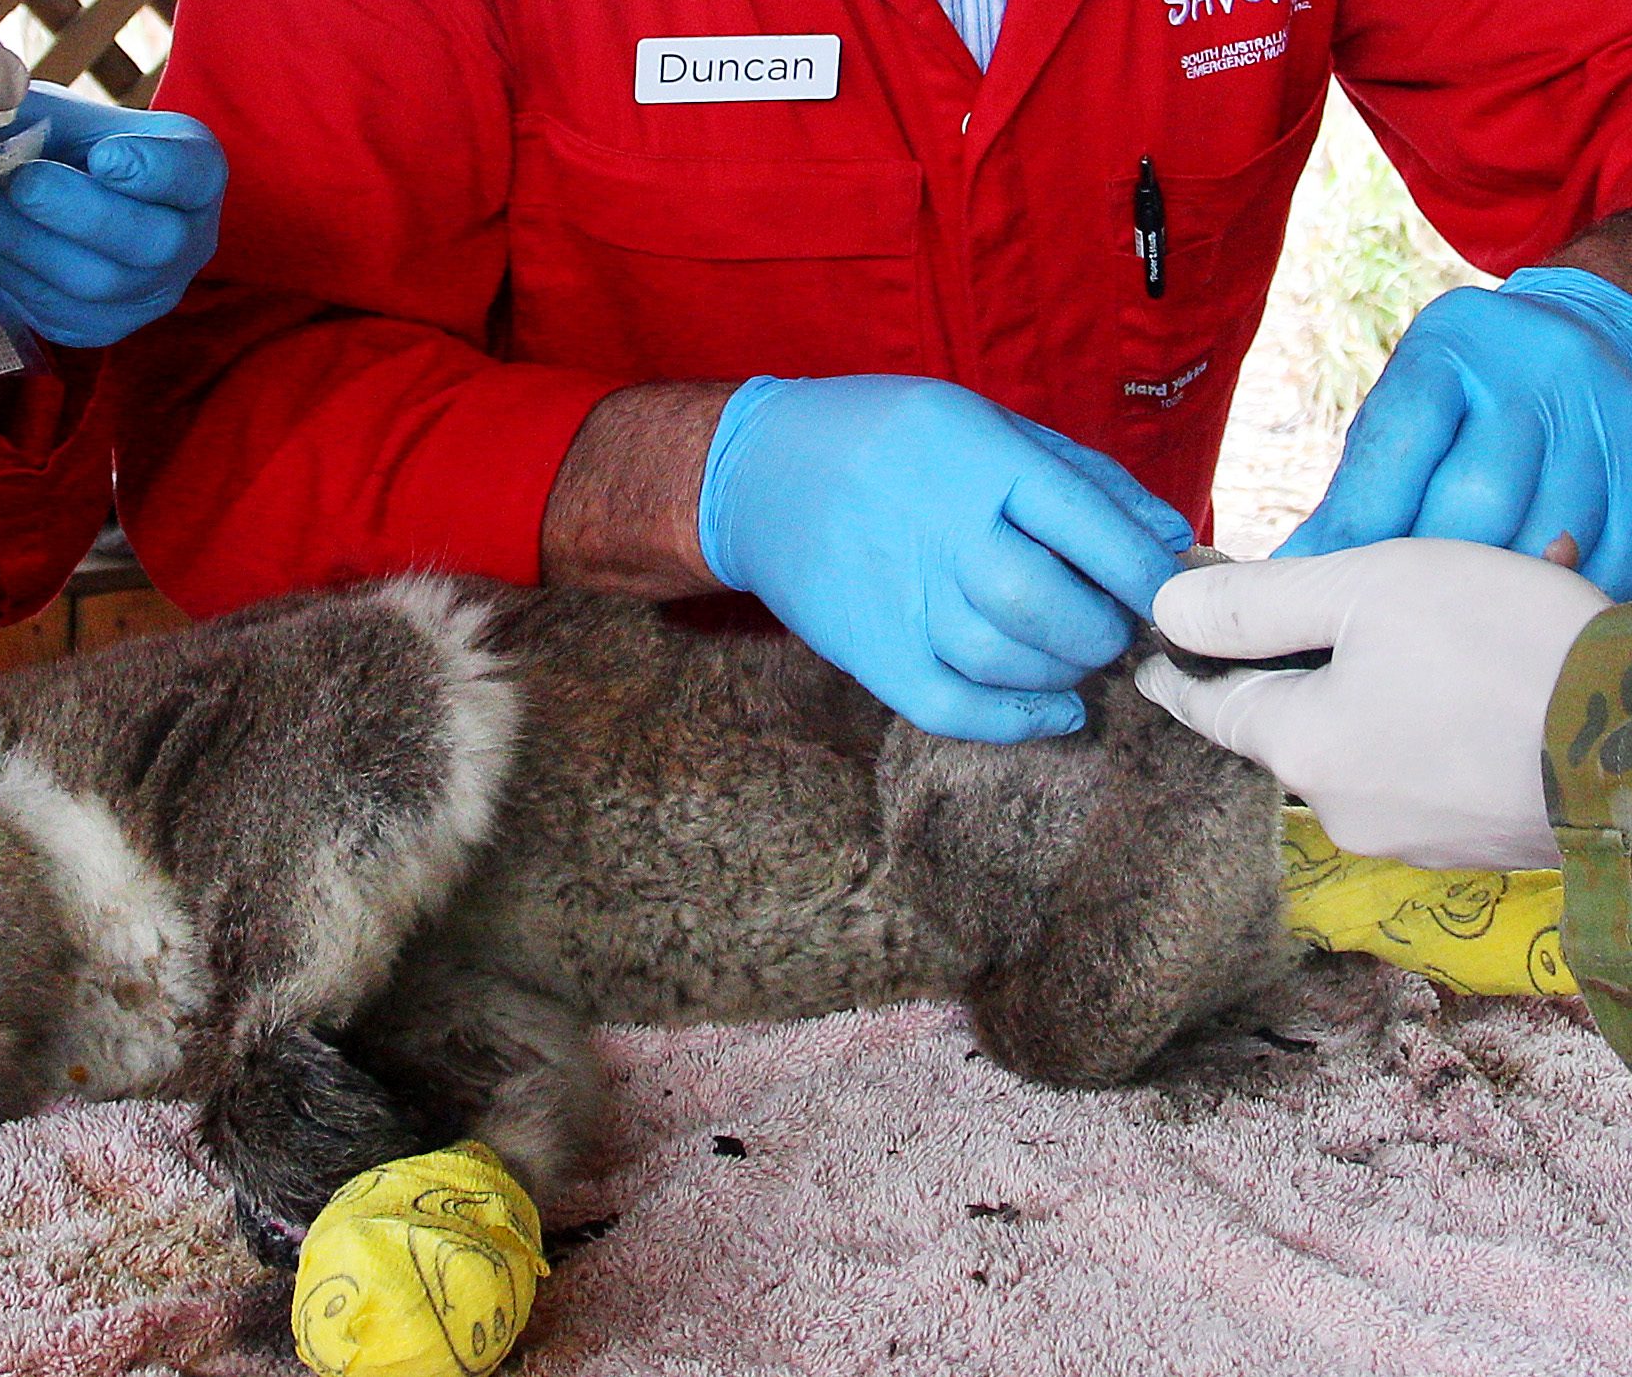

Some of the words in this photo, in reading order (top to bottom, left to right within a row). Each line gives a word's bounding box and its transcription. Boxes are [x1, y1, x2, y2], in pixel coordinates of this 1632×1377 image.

[659, 54, 815, 83] Duncan
[1180, 46, 1219, 70] SOUTH
[1186, 51, 1261, 80] EMERGENCY
[1124, 381, 1167, 397] Hard
